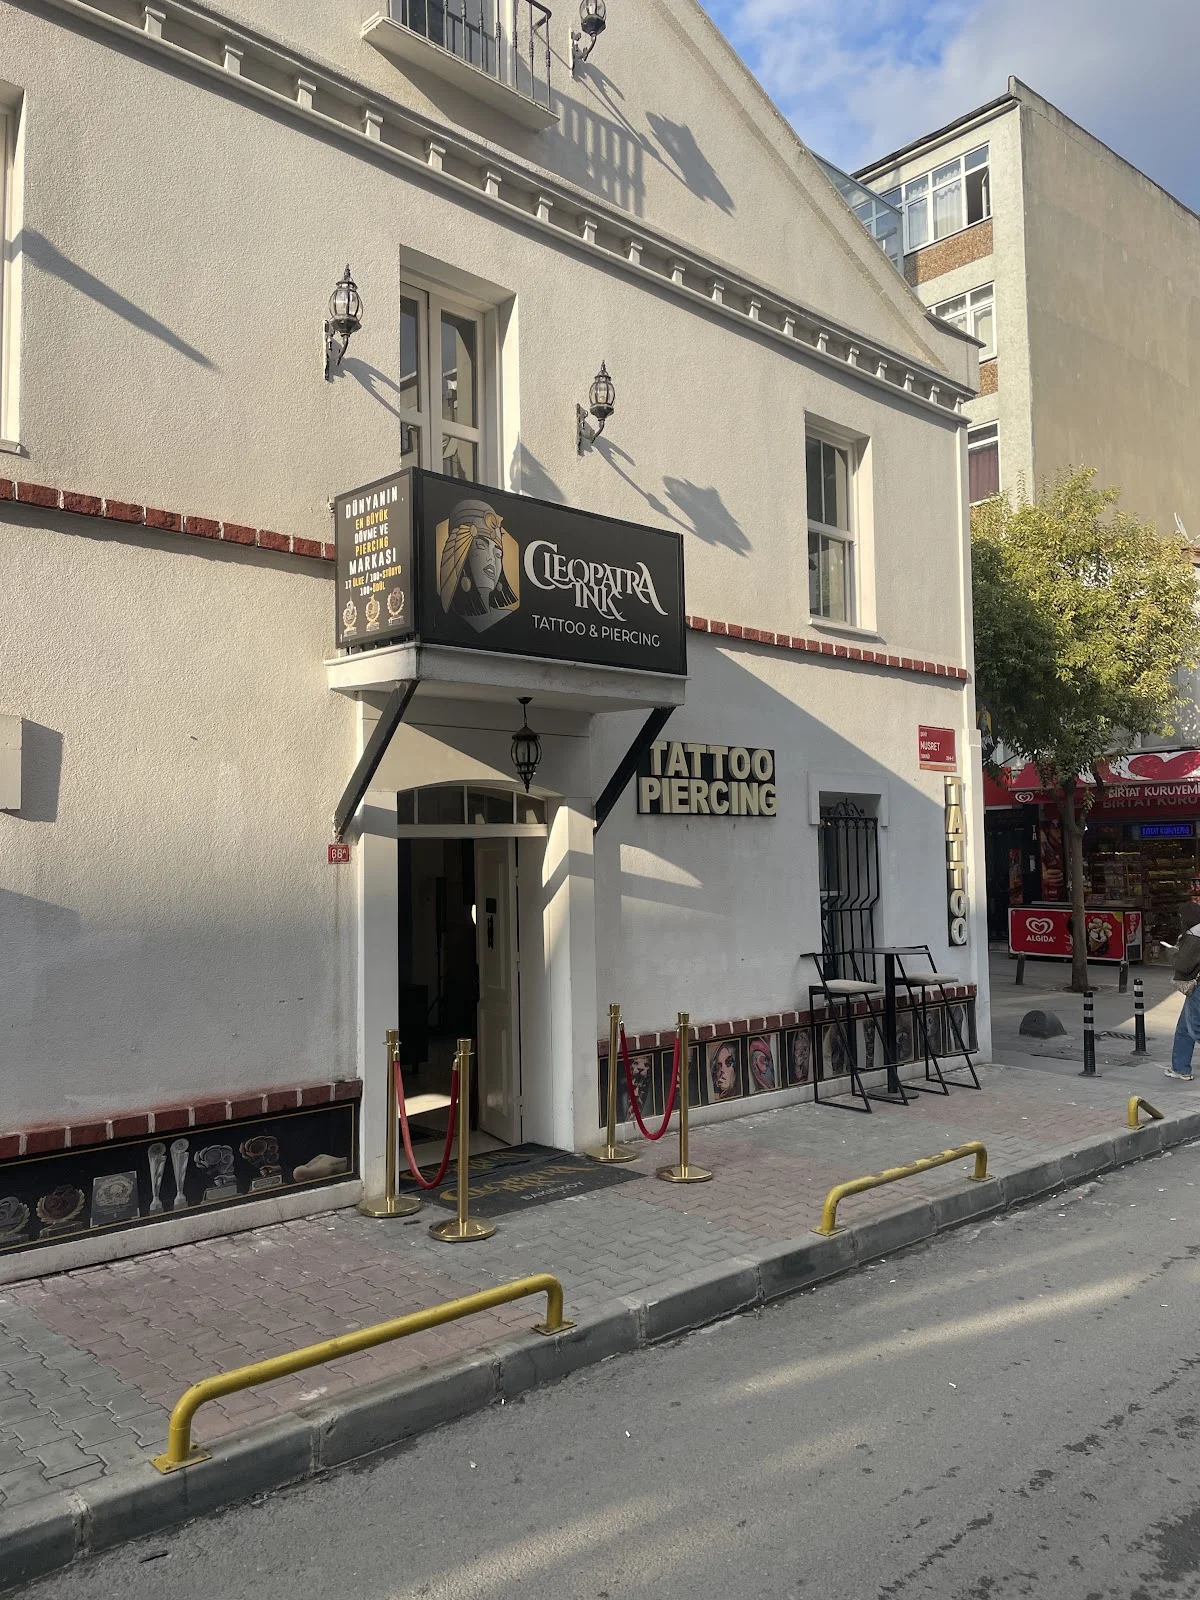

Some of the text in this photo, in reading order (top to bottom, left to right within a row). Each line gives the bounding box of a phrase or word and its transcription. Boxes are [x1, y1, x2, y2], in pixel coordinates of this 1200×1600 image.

[345, 485, 398, 519] DÜNYANIN
[355, 508, 389, 530] EN BÜYÜK
[355, 535, 389, 557] PIERCING
[379, 522, 389, 536] VE
[349, 547, 397, 575] MARKASI
[523, 540, 669, 616] CLEOPATRA
[574, 577, 628, 622] INK
[531, 614, 661, 648] TATTOO & PIERCING
[649, 740, 774, 782] TATTOO
[638, 776, 777, 816] PIERCING
[944, 775, 968, 946] TATTOO
[1026, 934, 1055, 943] ALGIDA
